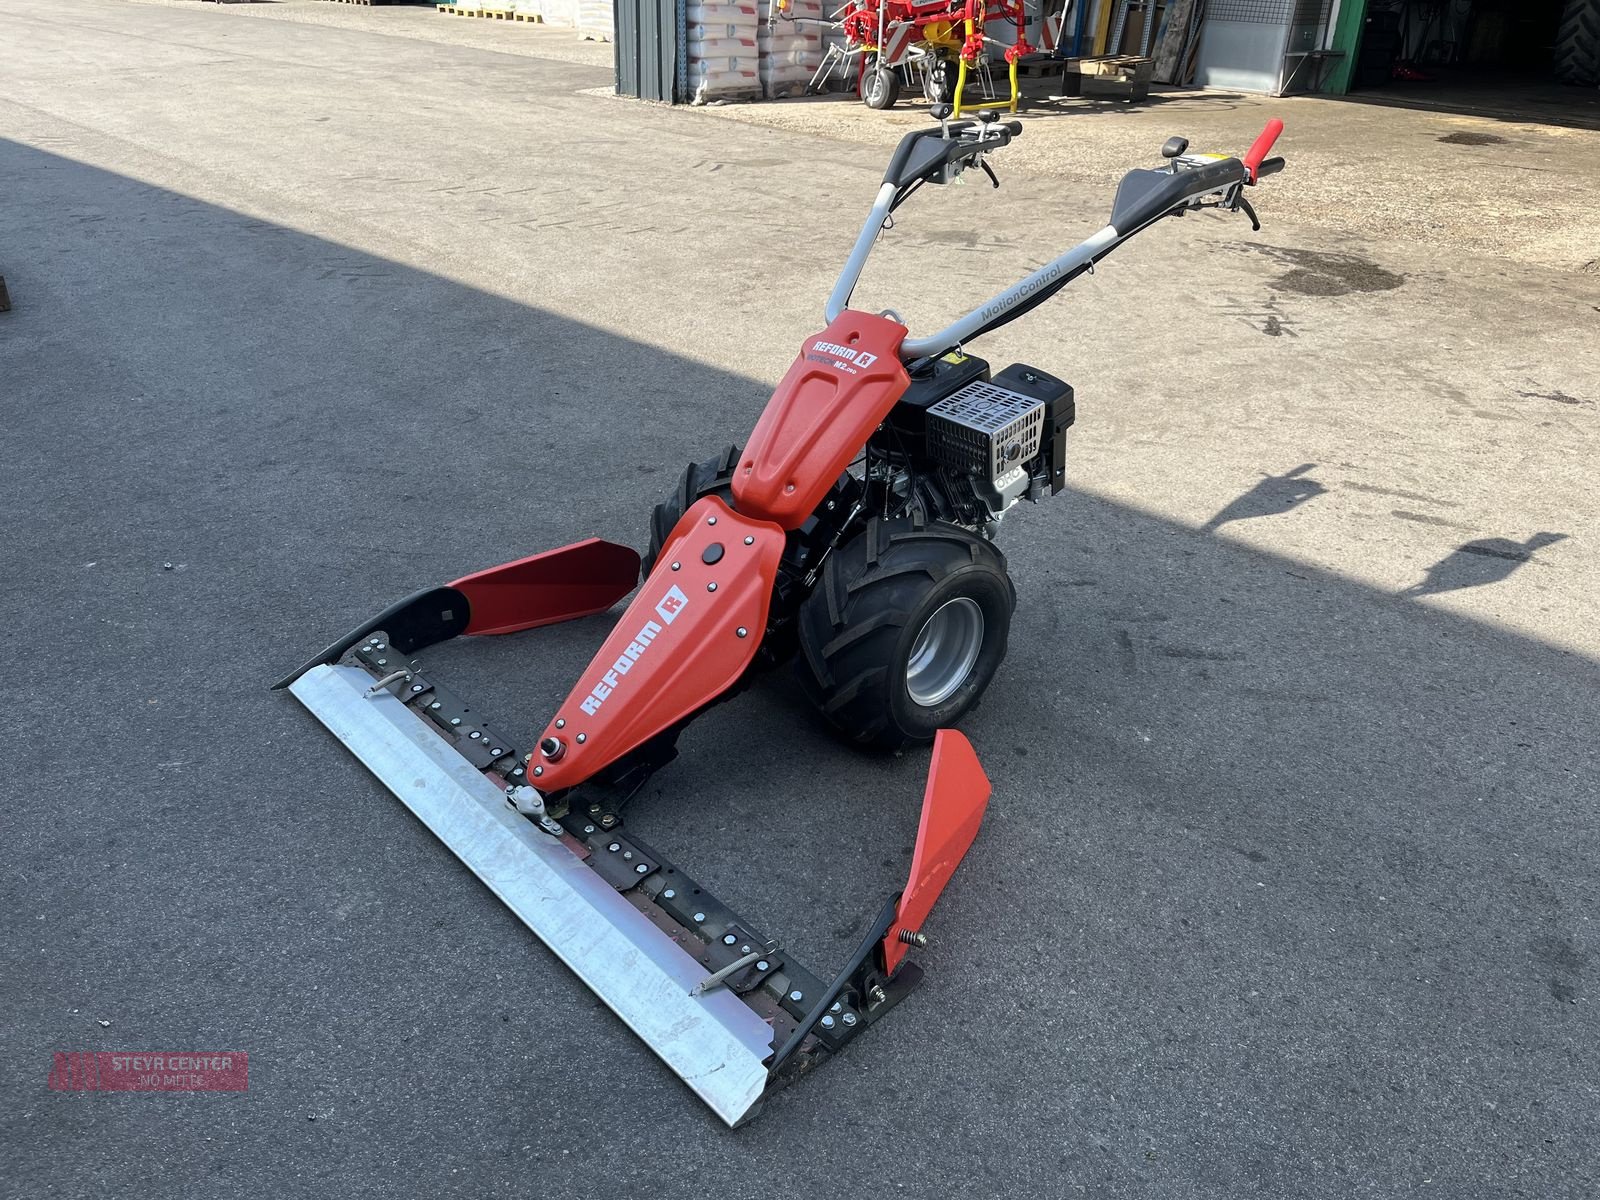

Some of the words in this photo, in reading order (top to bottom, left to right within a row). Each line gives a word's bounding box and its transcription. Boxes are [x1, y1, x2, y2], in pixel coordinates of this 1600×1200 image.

[980, 264, 1062, 322] MotionControl
[812, 341, 858, 361] REFORM
[996, 467, 1021, 489] OHC
[579, 620, 663, 716] REFORM
